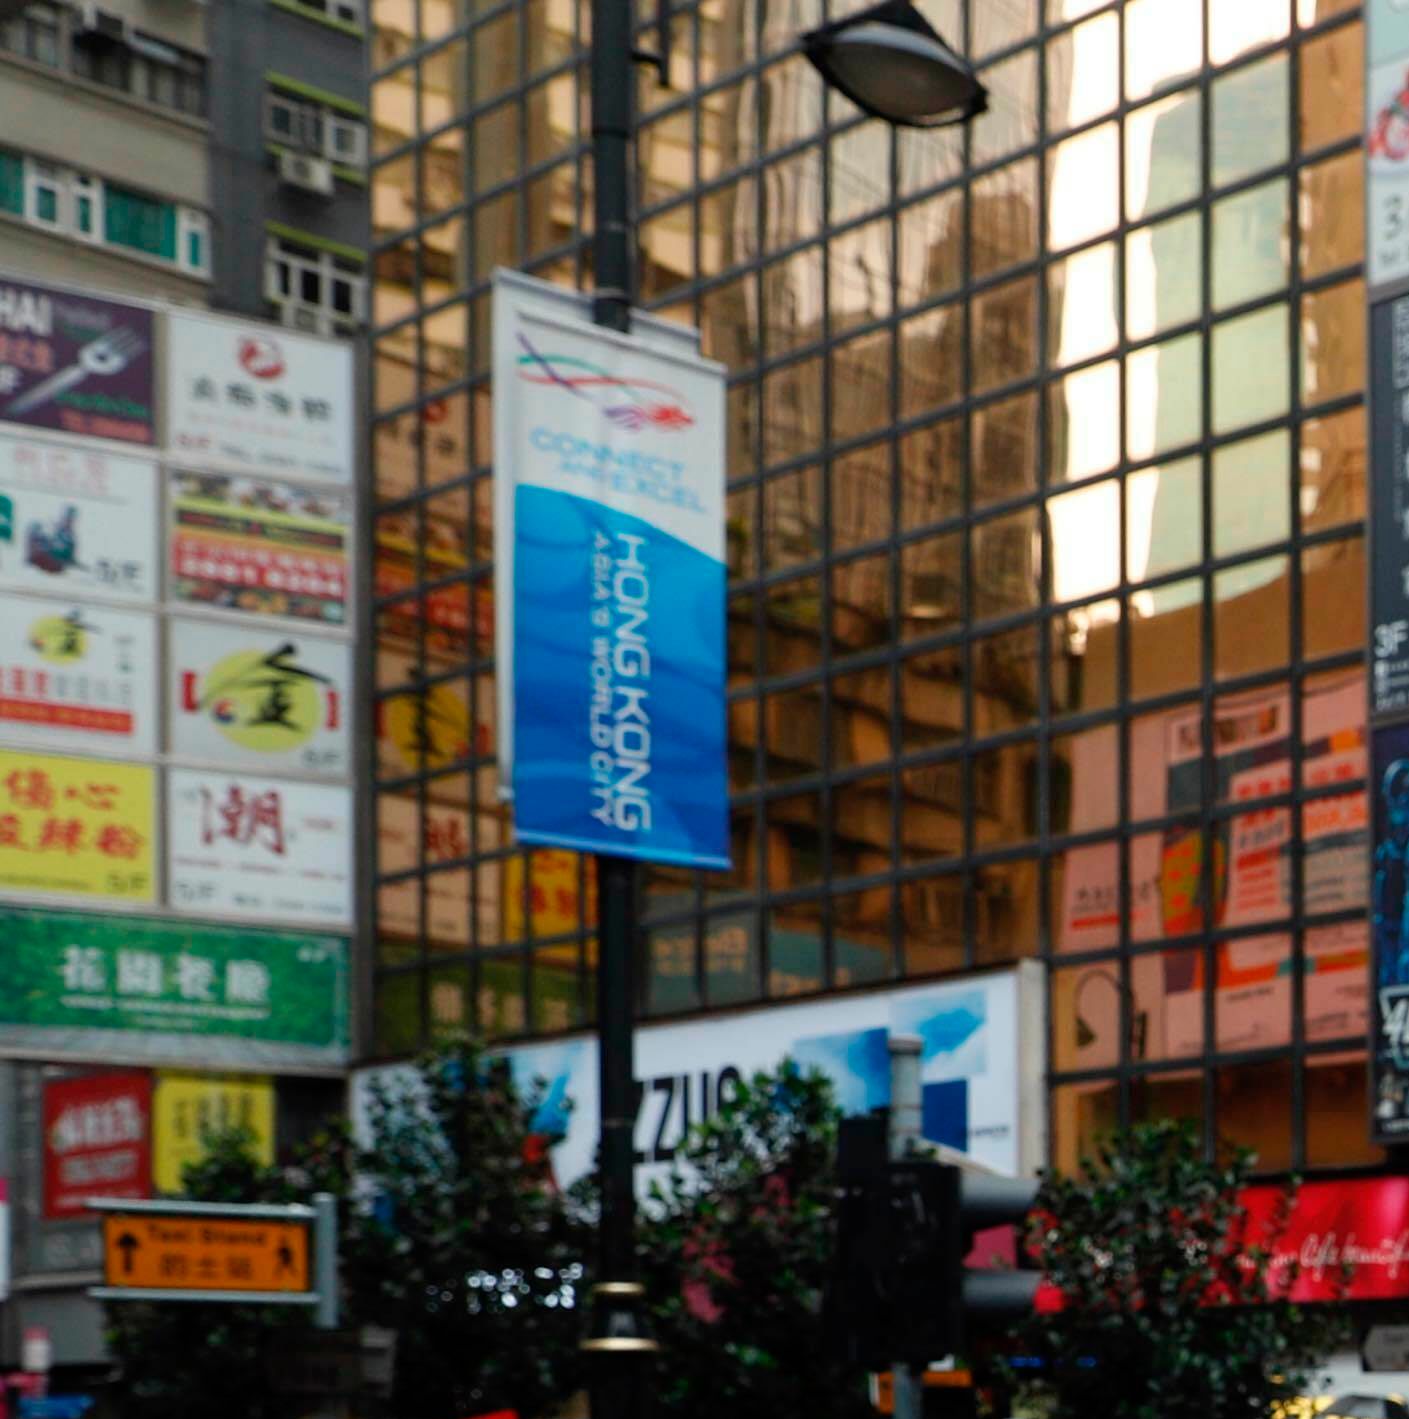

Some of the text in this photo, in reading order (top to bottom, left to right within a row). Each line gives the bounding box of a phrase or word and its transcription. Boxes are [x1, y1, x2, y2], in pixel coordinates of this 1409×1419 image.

[529, 426, 686, 479] CONNECT
[612, 532, 652, 832] HONG KONG
